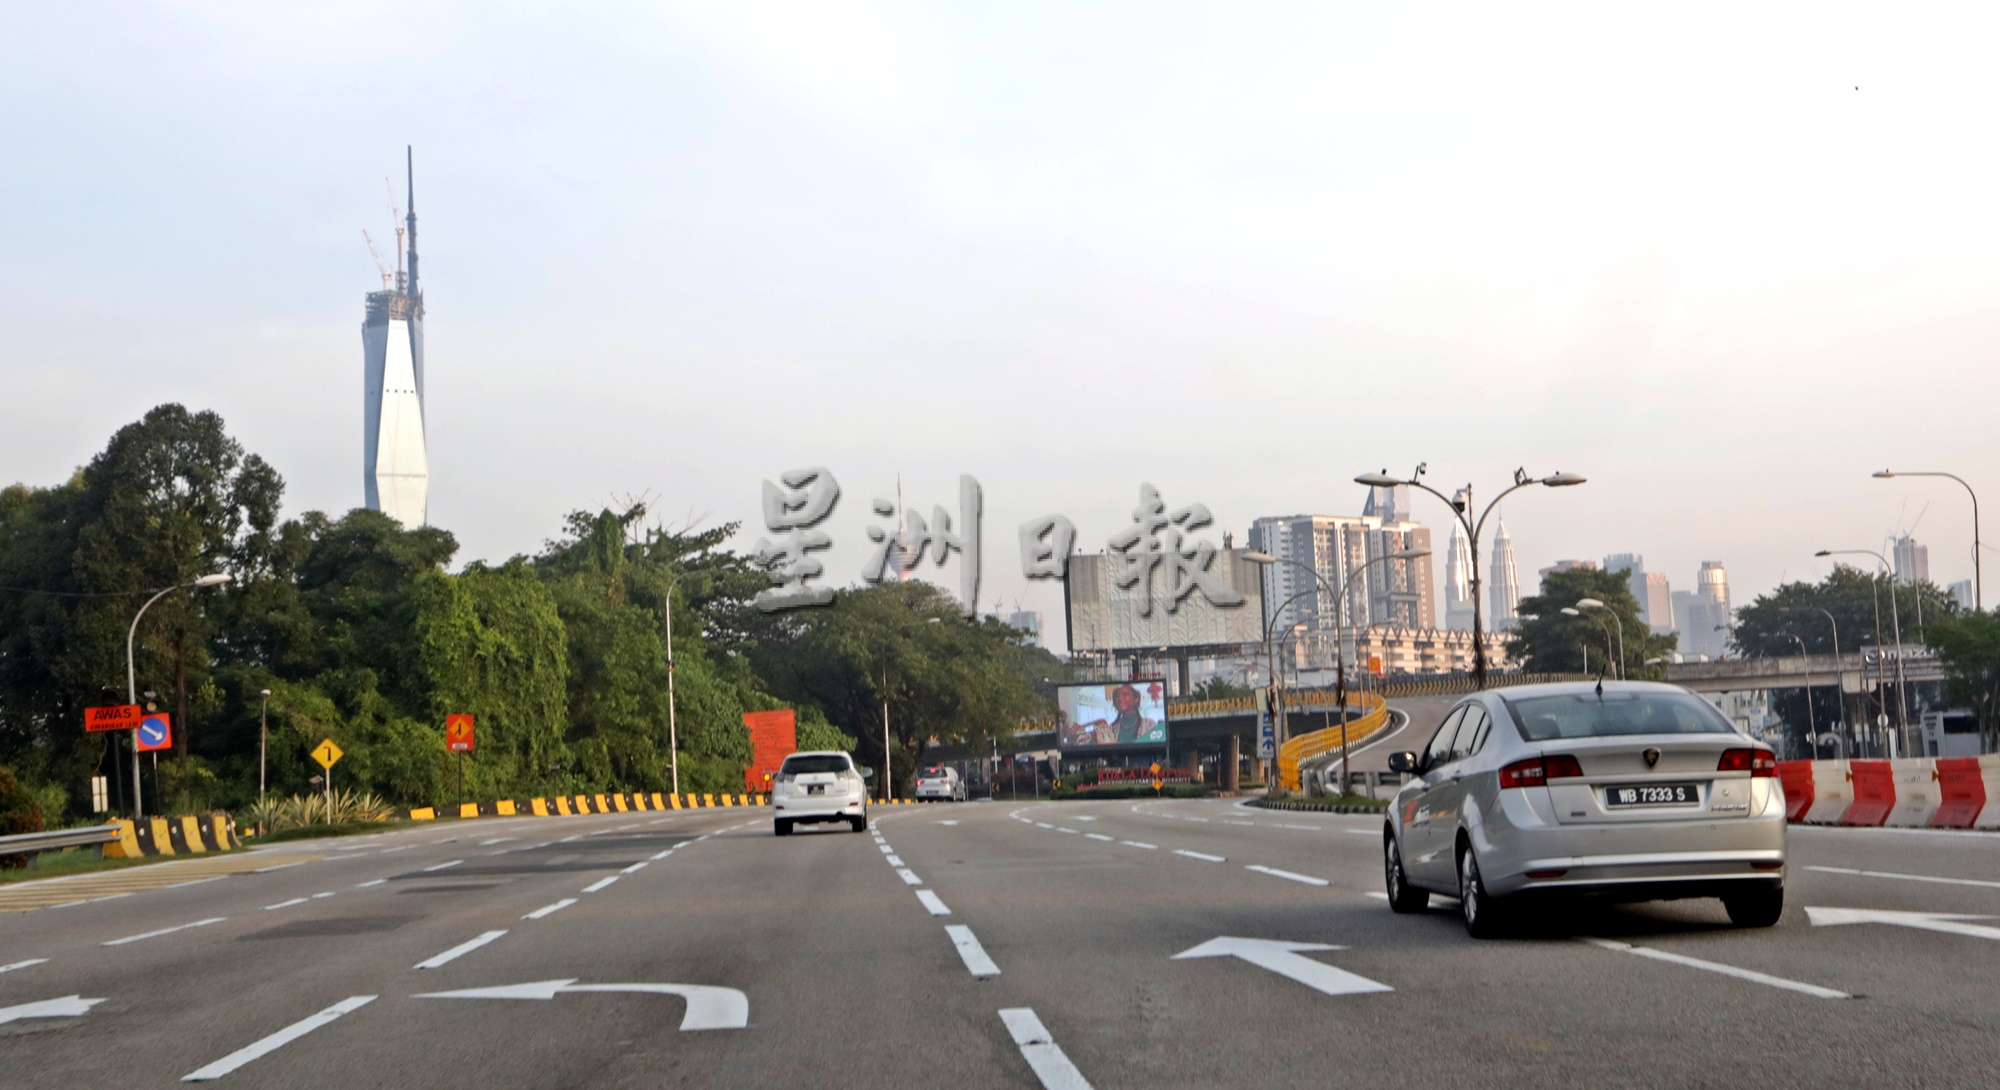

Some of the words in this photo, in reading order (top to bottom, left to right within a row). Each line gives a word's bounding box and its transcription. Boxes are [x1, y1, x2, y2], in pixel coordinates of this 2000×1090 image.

[94, 708, 132, 721] AWAS
[1618, 788, 1637, 804] WB
[1640, 787, 1673, 803] 7333
[1676, 786, 1686, 801] S
